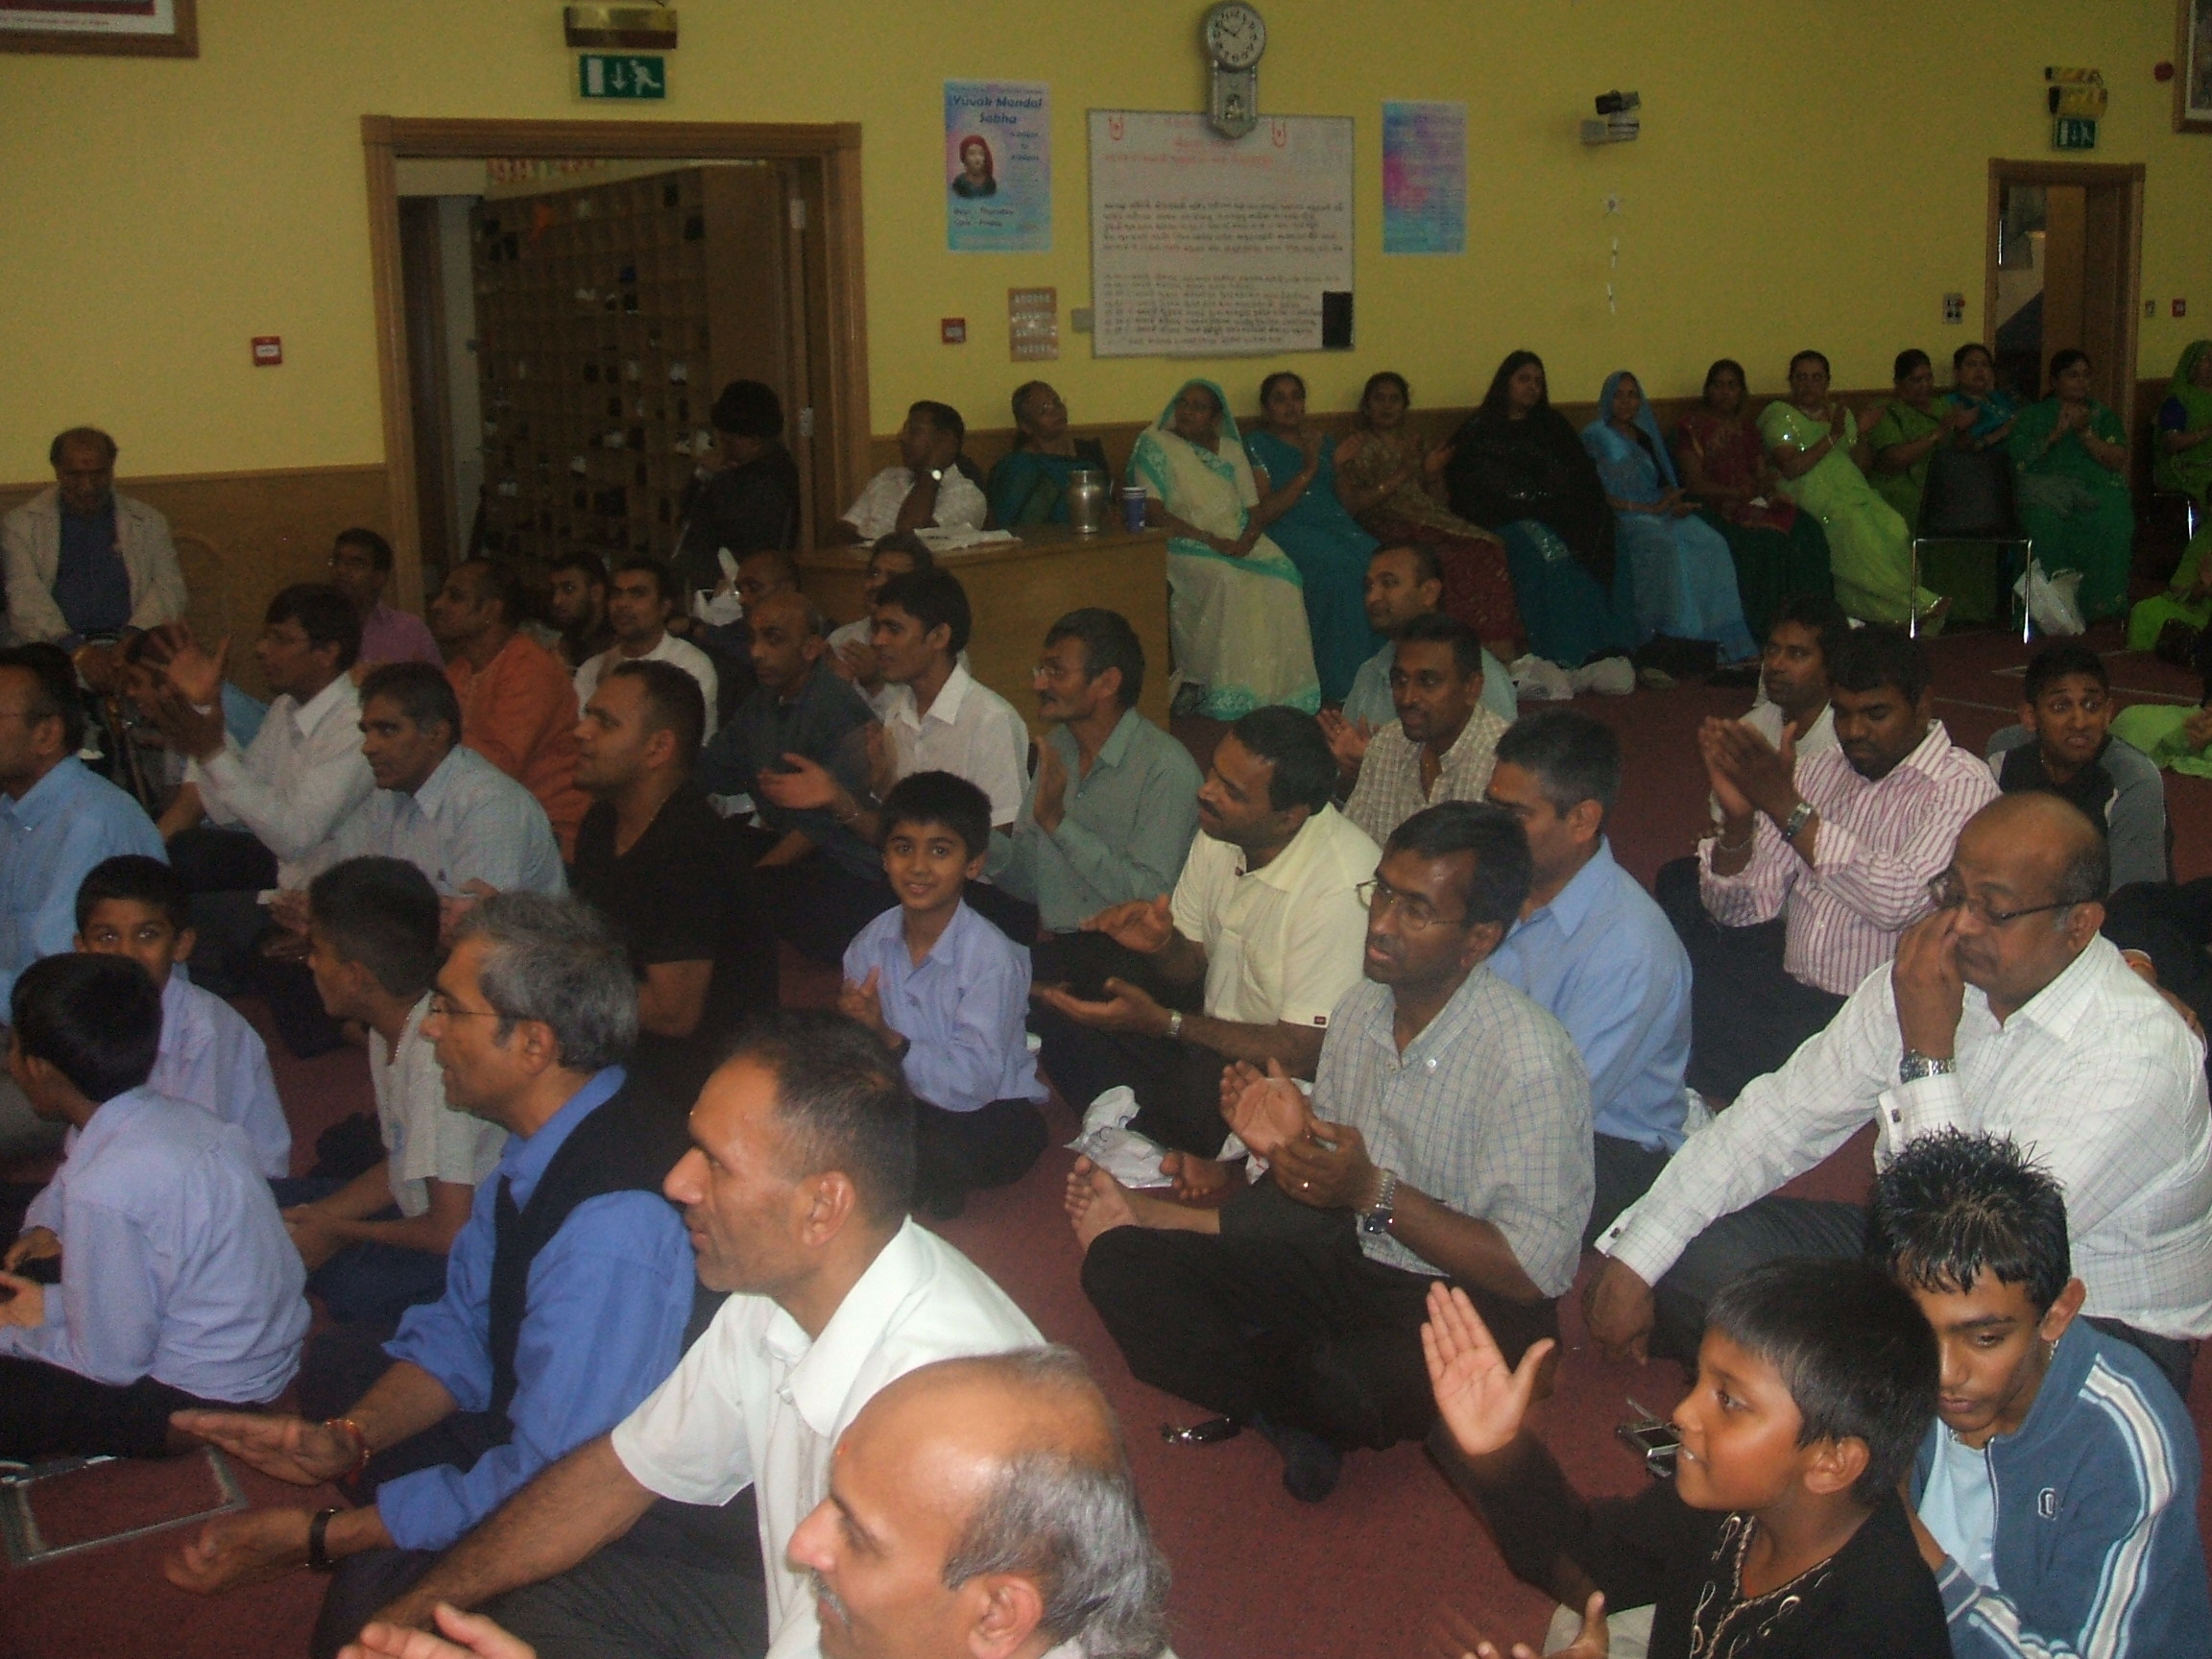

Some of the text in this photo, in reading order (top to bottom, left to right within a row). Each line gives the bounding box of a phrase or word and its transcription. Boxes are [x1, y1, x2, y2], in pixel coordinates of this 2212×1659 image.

[952, 93, 1043, 109] Yuvak Mandal
[979, 110, 1018, 125] Sabha
